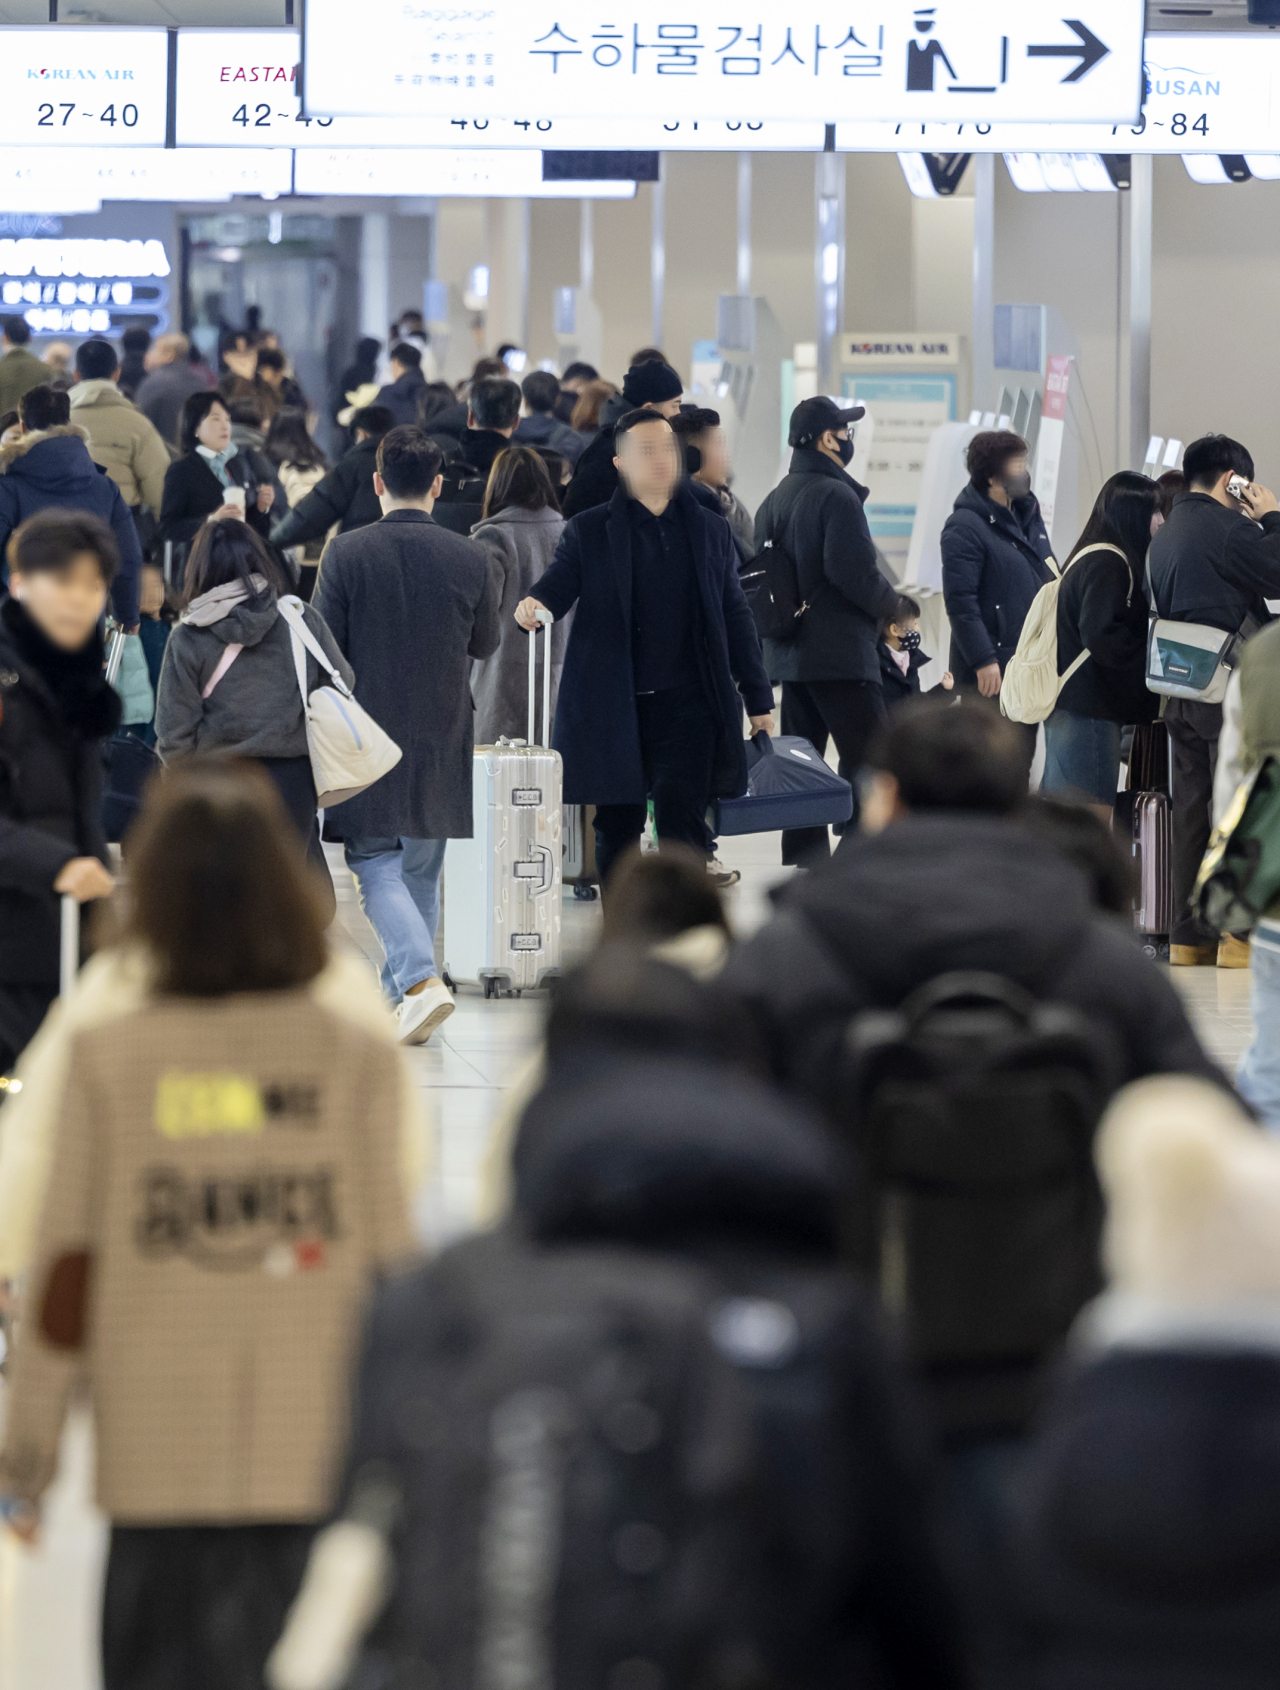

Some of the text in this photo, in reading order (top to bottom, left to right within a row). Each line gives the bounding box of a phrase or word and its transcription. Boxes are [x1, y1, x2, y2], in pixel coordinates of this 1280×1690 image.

[529, 22, 884, 76] 수하물검사실
[27, 68, 134, 80] KOREAN AIR
[37, 103, 138, 127] 27~40
[850, 343, 949, 355] KOREAN AIR
